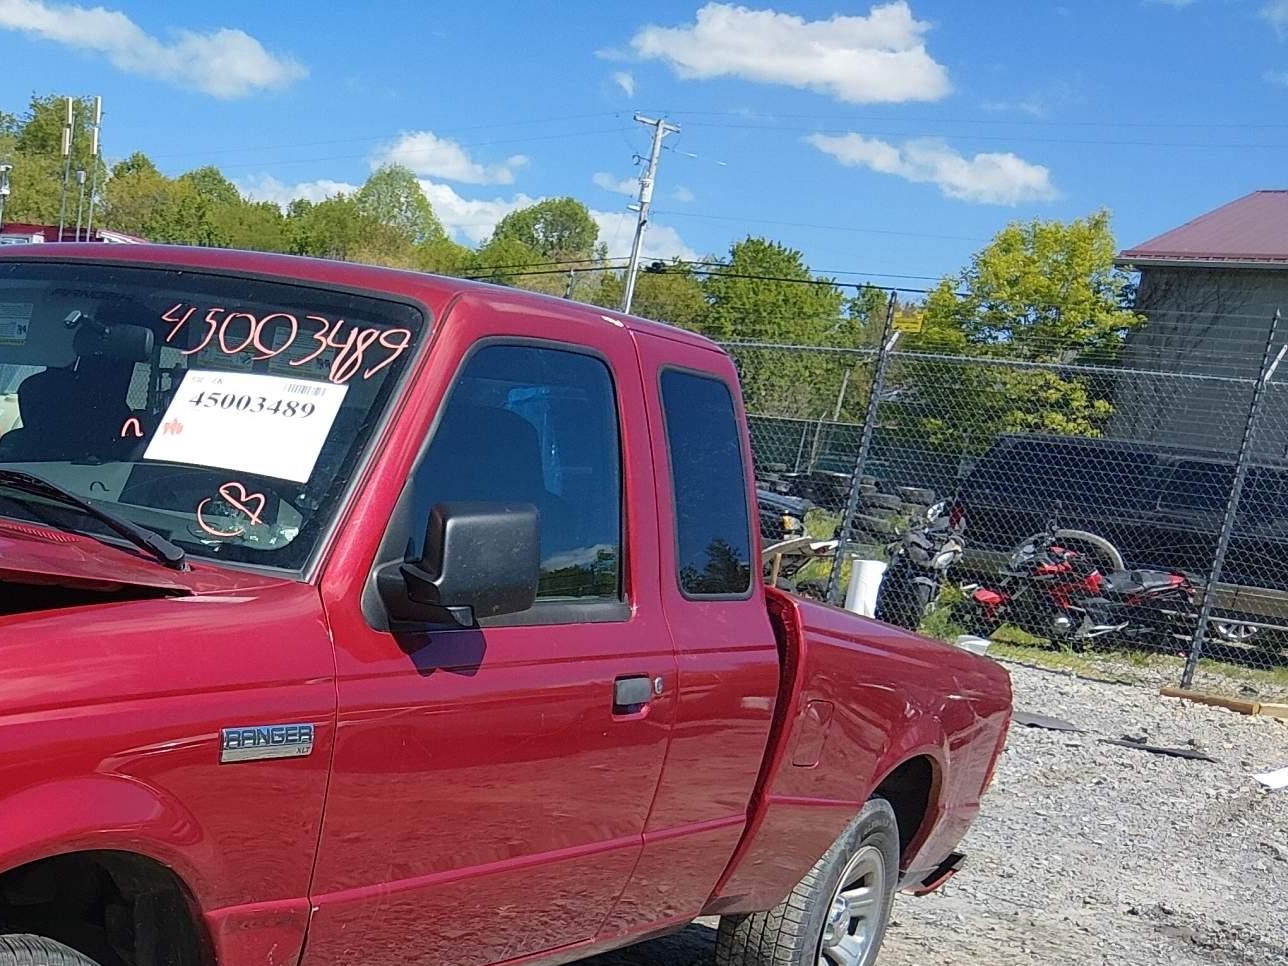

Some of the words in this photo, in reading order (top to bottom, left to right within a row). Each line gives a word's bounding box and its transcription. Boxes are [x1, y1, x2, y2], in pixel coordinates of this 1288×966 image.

[161, 303, 411, 385] 45003489
[189, 391, 316, 419] 45003489
[224, 725, 313, 749] RANGER
[295, 746, 311, 754] XLT
